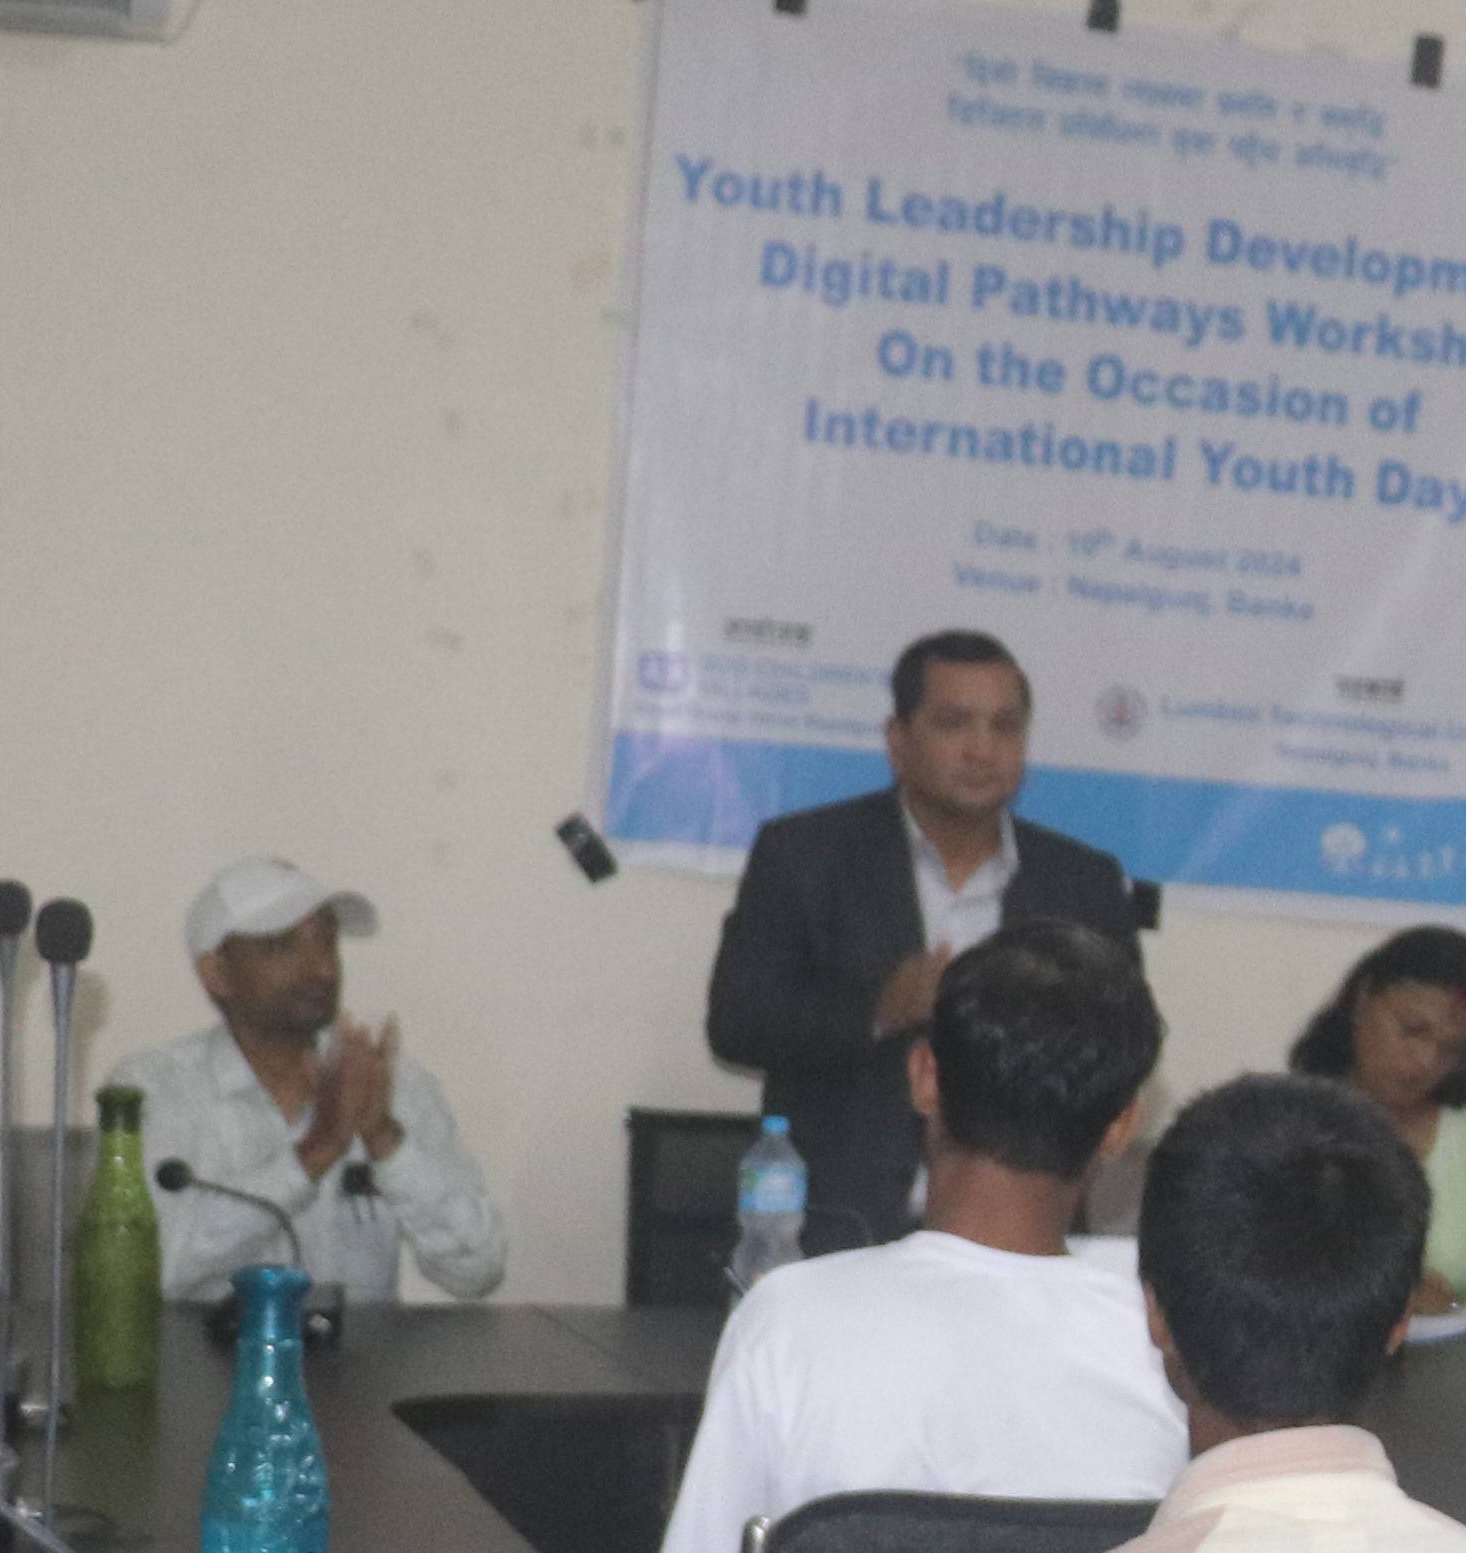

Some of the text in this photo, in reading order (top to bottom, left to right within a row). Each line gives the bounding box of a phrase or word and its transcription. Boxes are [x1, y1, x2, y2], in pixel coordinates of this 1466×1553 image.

[675, 154, 843, 218] Youth
[865, 178, 1186, 272] Leadership
[759, 240, 950, 308] Digital
[971, 263, 1245, 349] Pathways
[876, 329, 1423, 434] On the Occasion of
[803, 396, 1181, 481] International
[1199, 440, 1356, 501] Youth
[952, 562, 1042, 596] Venue
[972, 520, 1038, 552] Date
[1121, 537, 1230, 572] August
[1234, 549, 1303, 579] 2024
